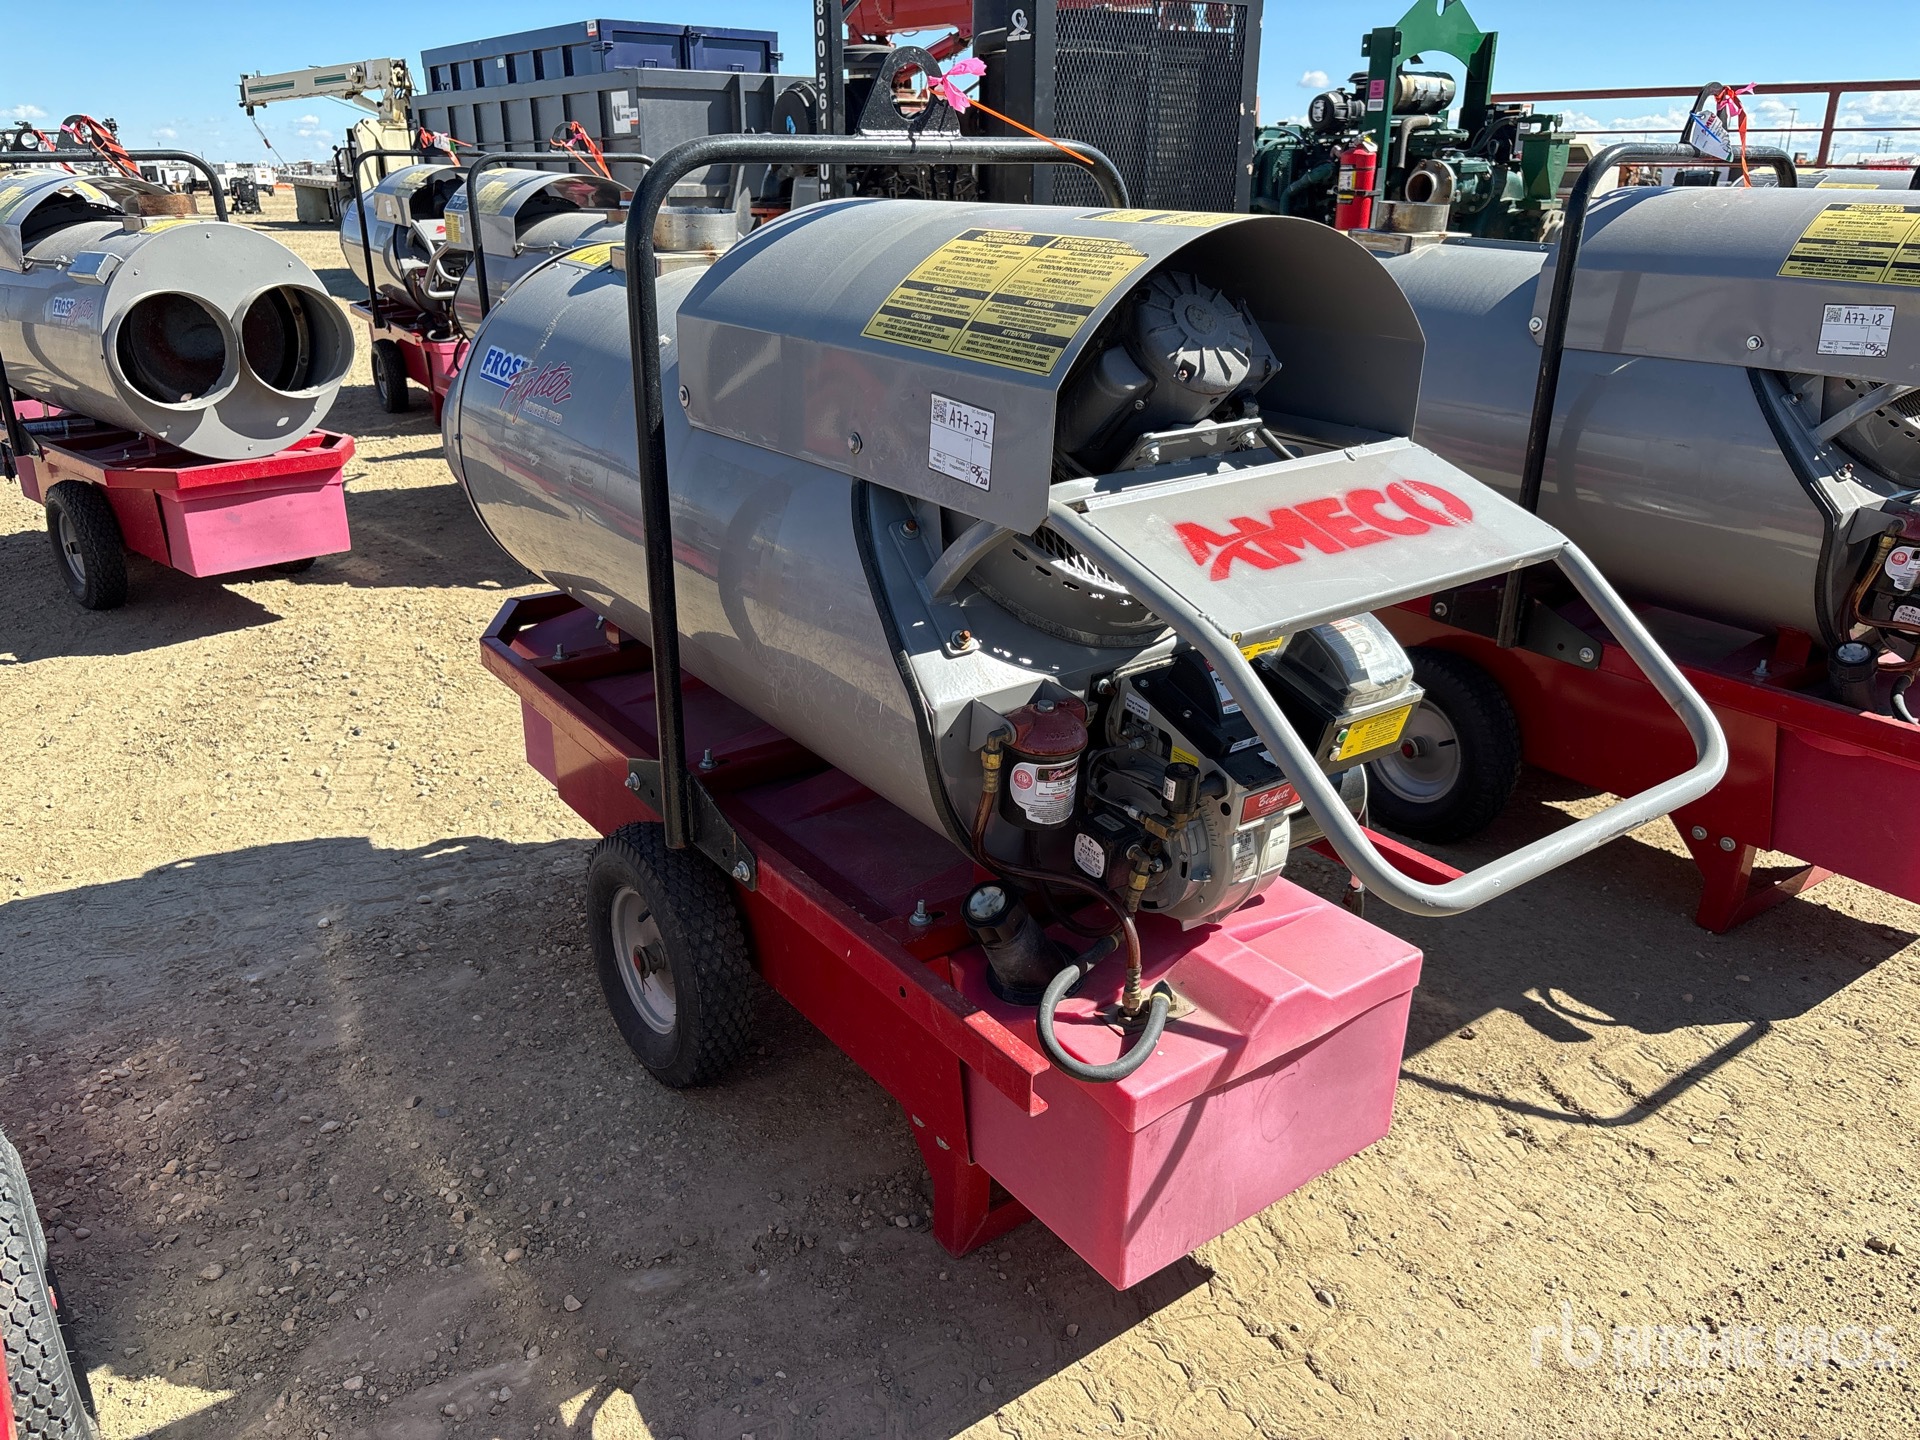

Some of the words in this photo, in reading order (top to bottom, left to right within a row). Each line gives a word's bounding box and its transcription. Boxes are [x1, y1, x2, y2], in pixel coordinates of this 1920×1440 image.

[1042, 278, 1081, 286] CARBURANT
[1024, 300, 1056, 308] ATTENTION
[1844, 310, 1885, 326] A77-18
[1002, 330, 1032, 339] ATTENTION
[949, 406, 988, 440] A77-27
[1174, 479, 1473, 581] AMECO
[1258, 787, 1290, 808] Beckett
